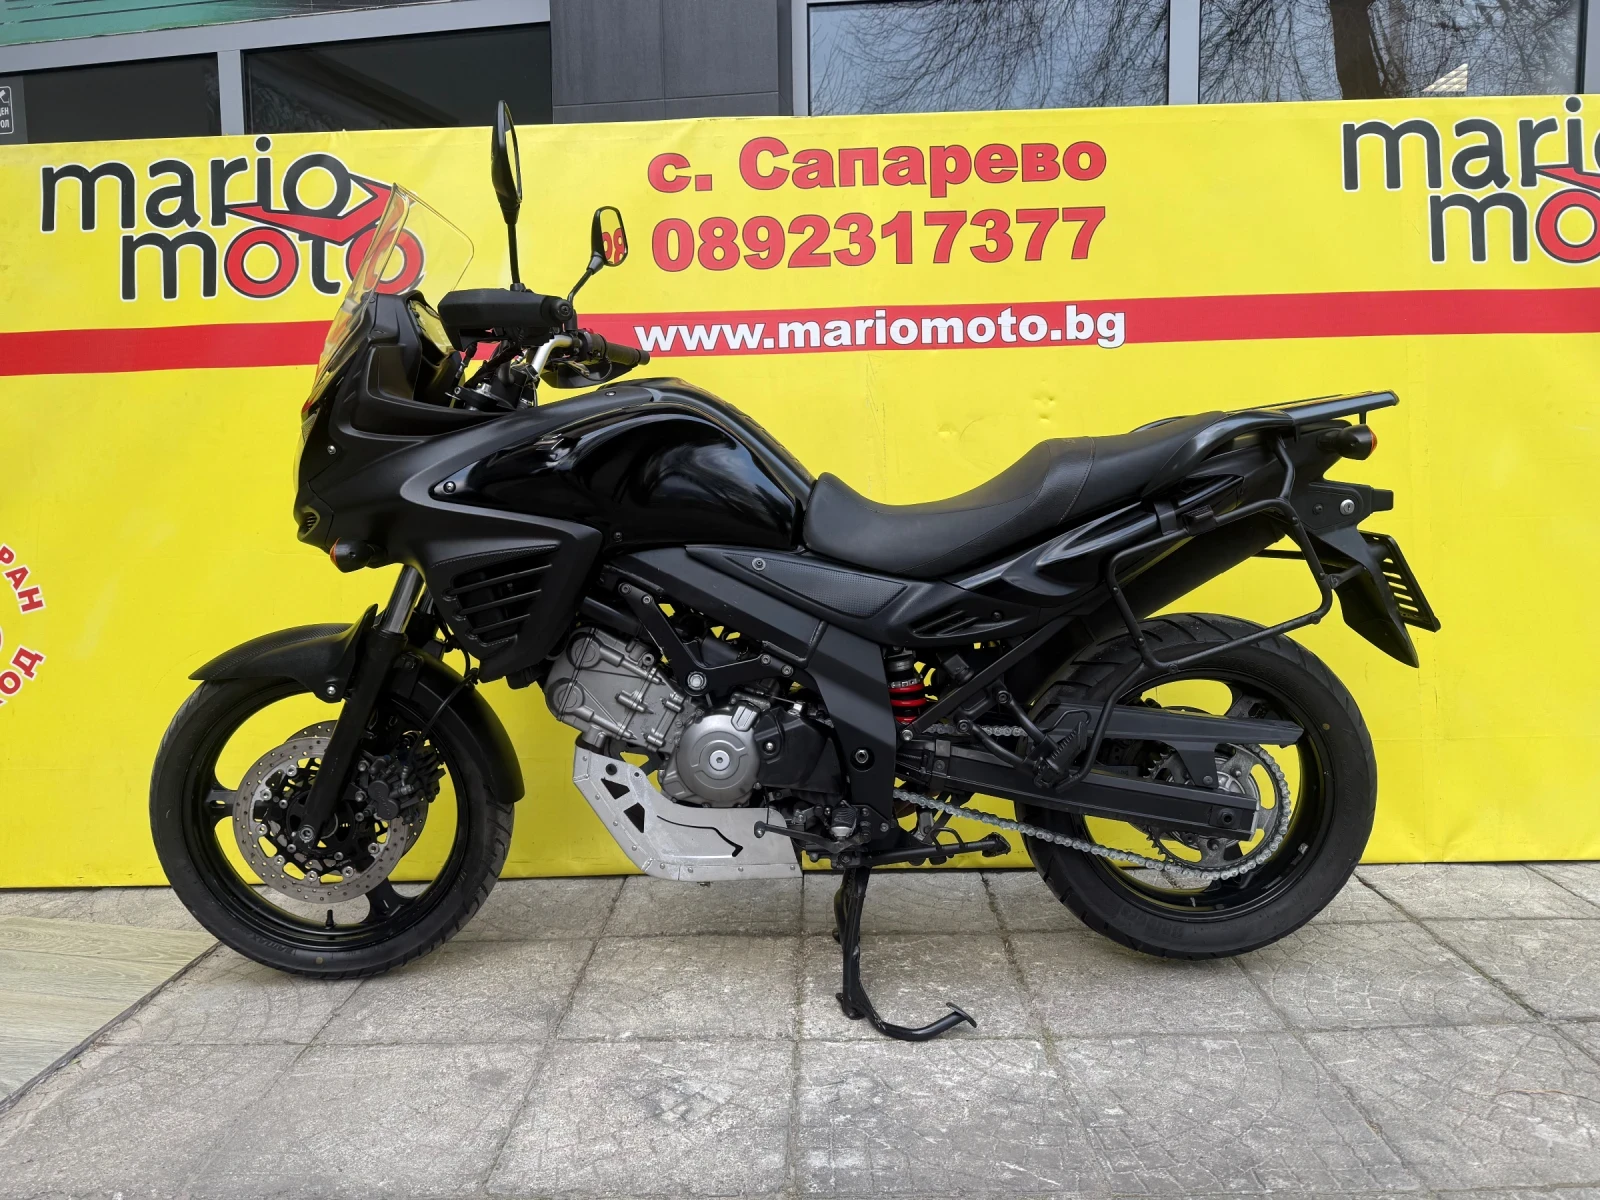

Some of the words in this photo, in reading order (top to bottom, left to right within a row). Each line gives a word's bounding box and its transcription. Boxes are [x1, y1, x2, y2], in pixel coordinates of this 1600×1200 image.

[0, 107, 9, 116] ЕН
[0, 119, 9, 128] ОЛ
[648, 153, 712, 193] с.
[739, 137, 1107, 198] Сапарево
[1342, 96, 1600, 189] mari
[42, 136, 352, 231] mario
[122, 226, 424, 299] moto
[652, 206, 1106, 272] 0892317377
[634, 304, 1126, 349] www.mariomoto.bg
[0, 647, 44, 704] ОД
